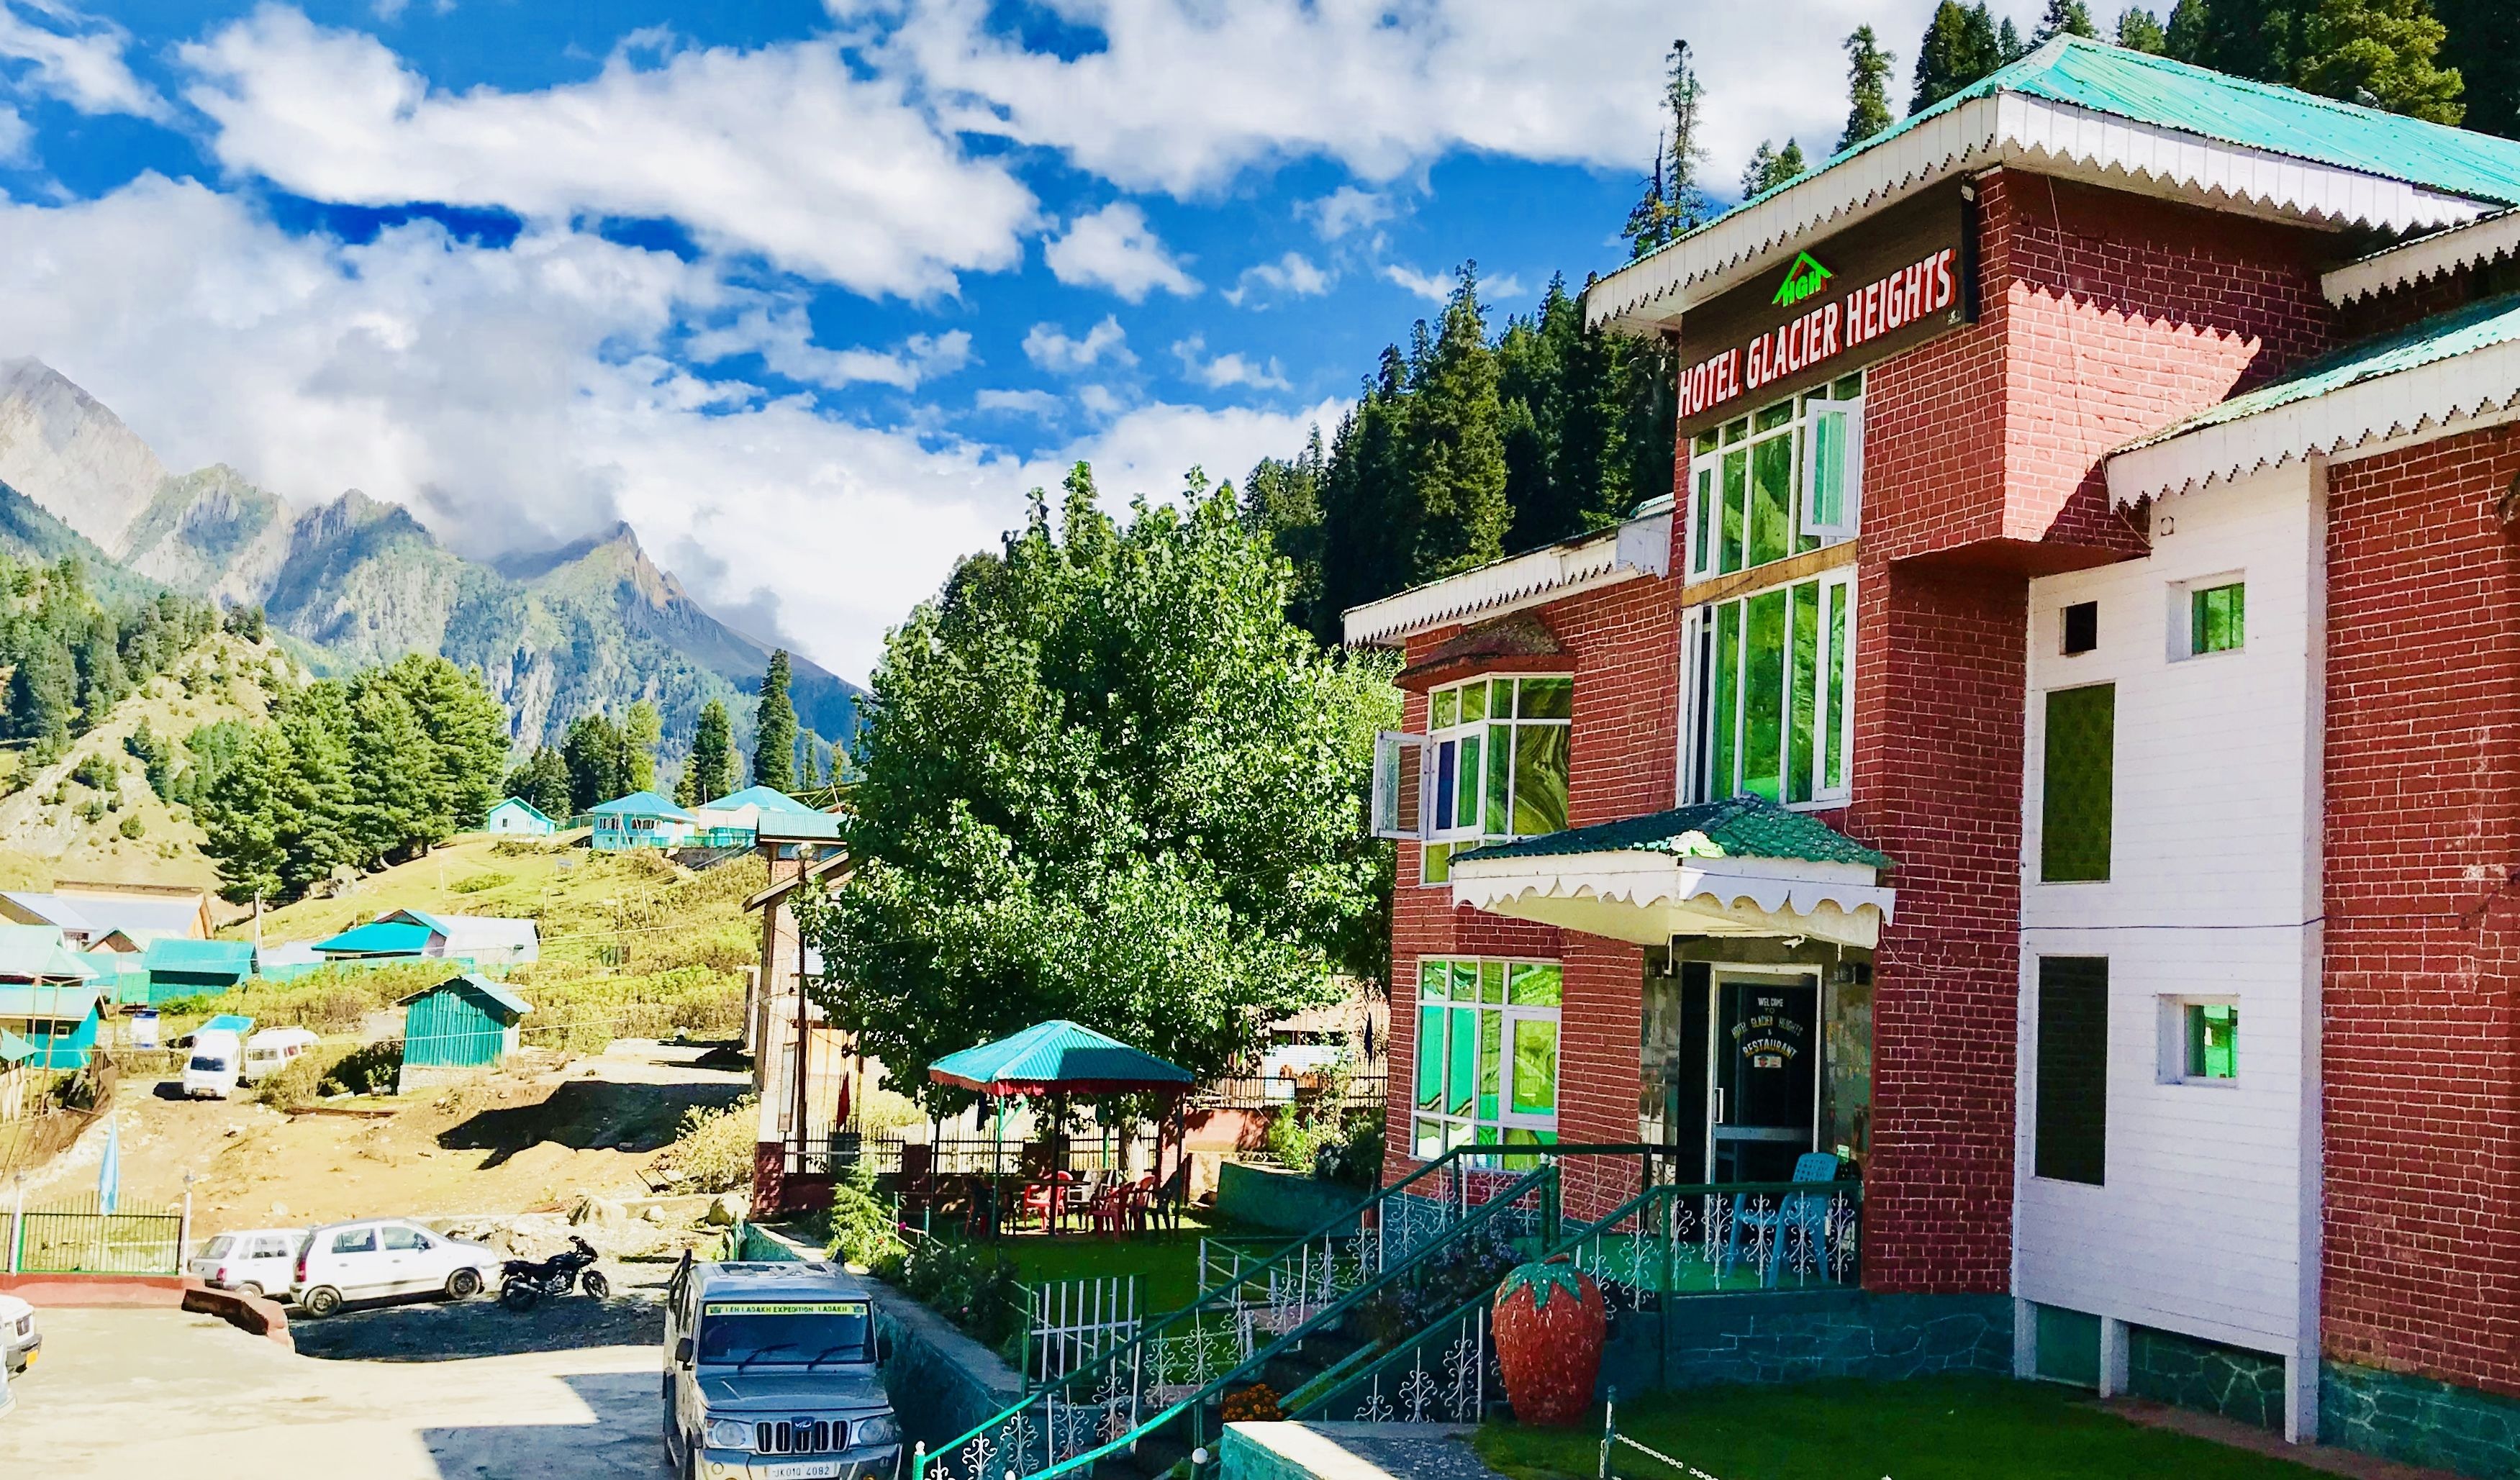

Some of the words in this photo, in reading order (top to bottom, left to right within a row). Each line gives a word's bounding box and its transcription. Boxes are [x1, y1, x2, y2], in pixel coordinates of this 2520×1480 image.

[1782, 271, 1821, 307] HGH
[1678, 348, 1742, 419] HOTEL
[1746, 301, 1841, 390] GLACIER
[1846, 248, 1955, 348] HEIGHTS
[1731, 1022, 1749, 1039] HOTEL
[1750, 1015, 1774, 1028] GLACIER
[1778, 1017, 1803, 1036] HEIGHTS
[1742, 1038, 1798, 1060] RESTAURANT
